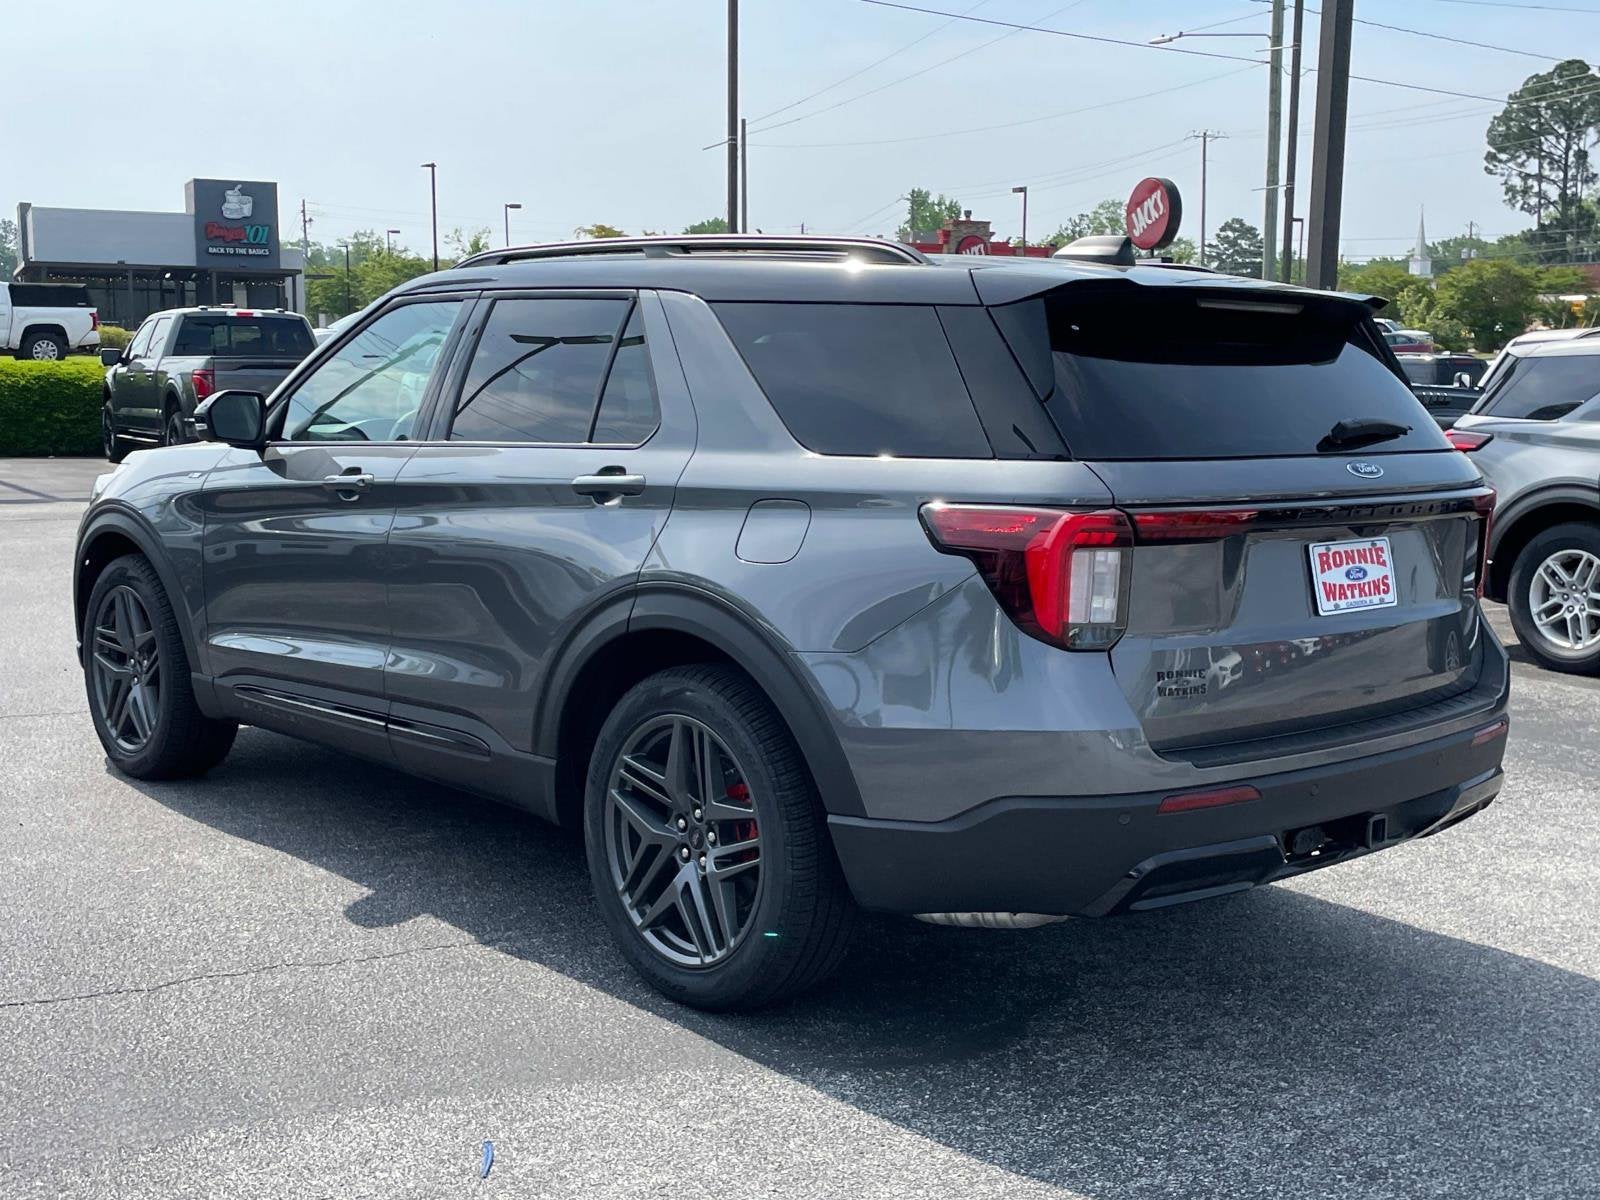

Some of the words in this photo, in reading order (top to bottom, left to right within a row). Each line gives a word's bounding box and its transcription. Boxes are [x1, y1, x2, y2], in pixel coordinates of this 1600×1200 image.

[242, 225, 270, 244] 101
[248, 248, 269, 256] BASICS
[1317, 546, 1387, 574] RONNIE
[1321, 574, 1391, 602] WATKINS
[1156, 668, 1206, 682] RONNIE
[1157, 683, 1207, 697] WATKINS
